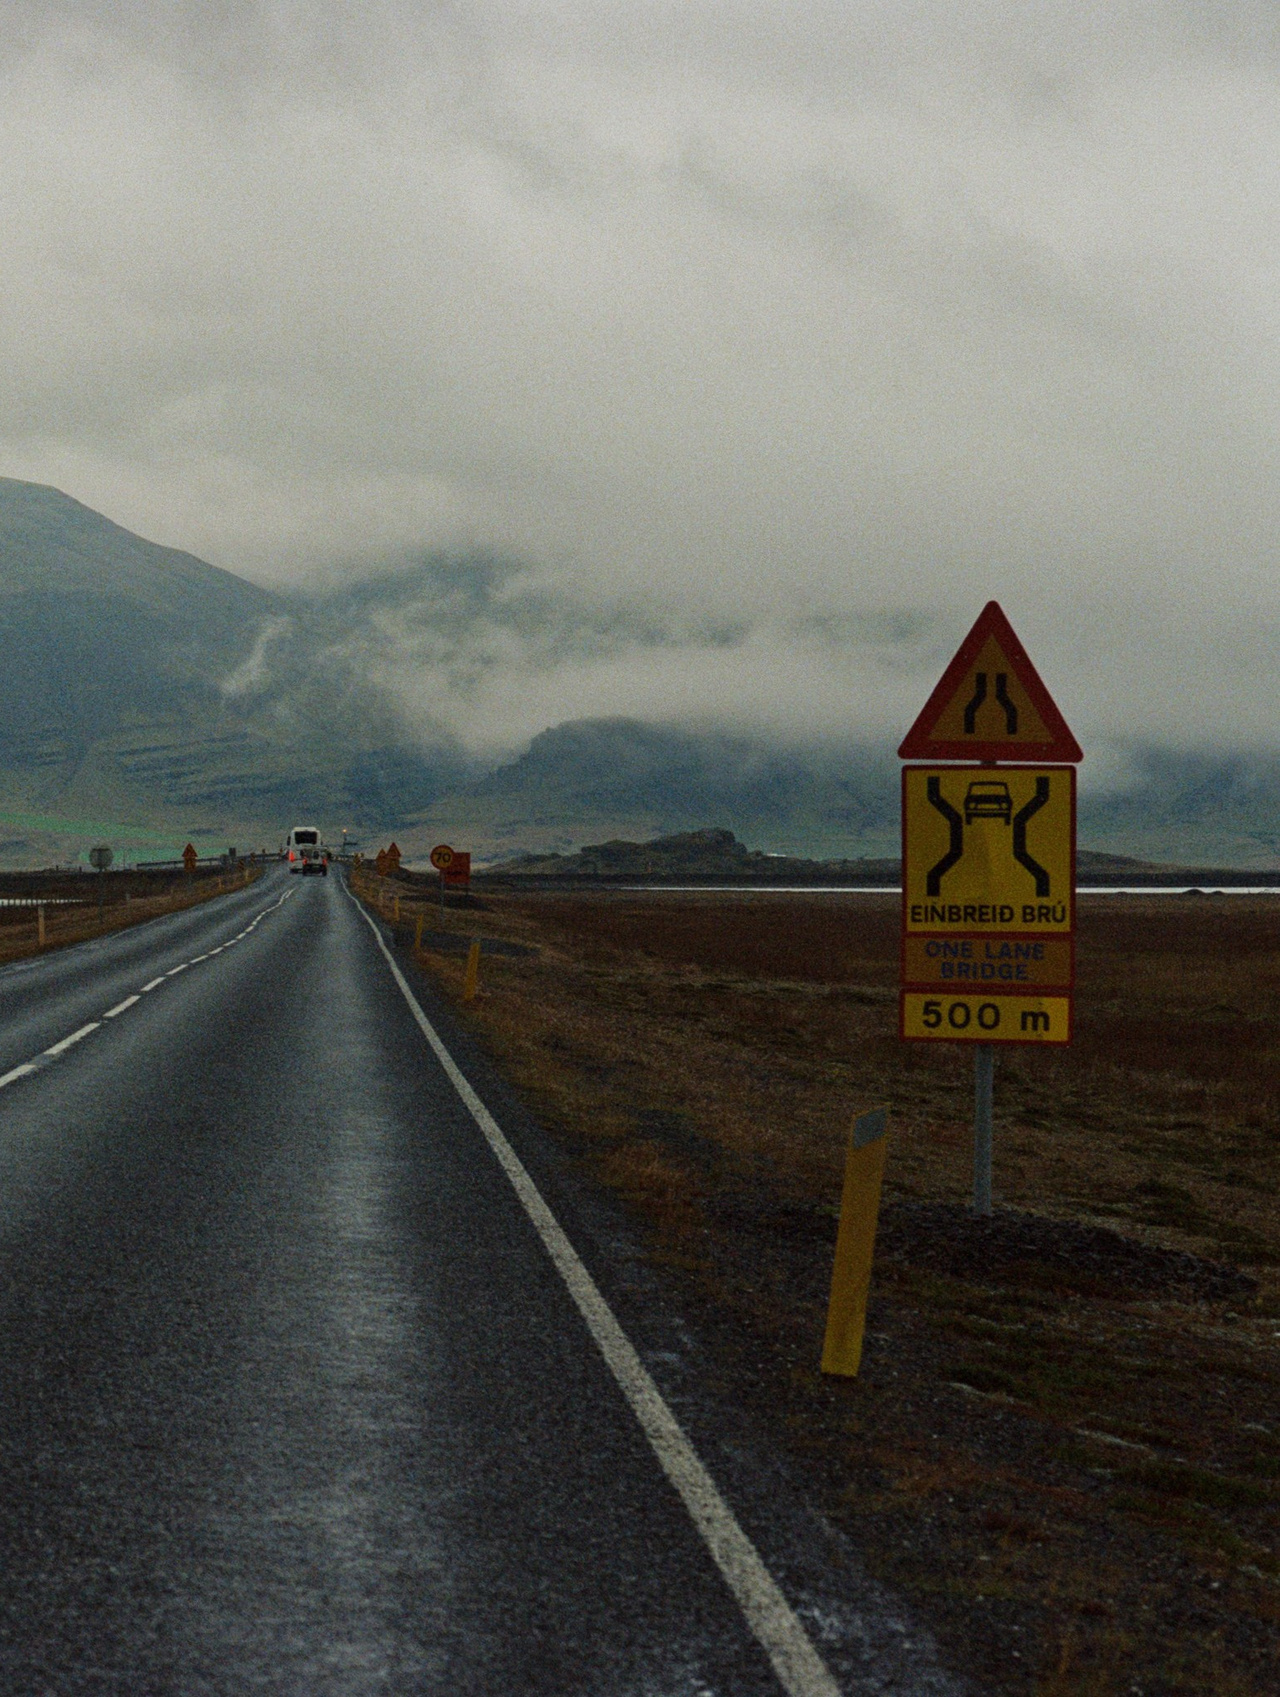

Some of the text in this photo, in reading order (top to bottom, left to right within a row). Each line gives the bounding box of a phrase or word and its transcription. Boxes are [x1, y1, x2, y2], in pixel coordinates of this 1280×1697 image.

[433, 852, 451, 862] 70
[911, 901, 1066, 923] EINBREIÐ BRÚ
[925, 940, 1045, 961] ONE LANE
[941, 961, 1029, 980] BRIDGE
[922, 1000, 1050, 1031] 500 m
